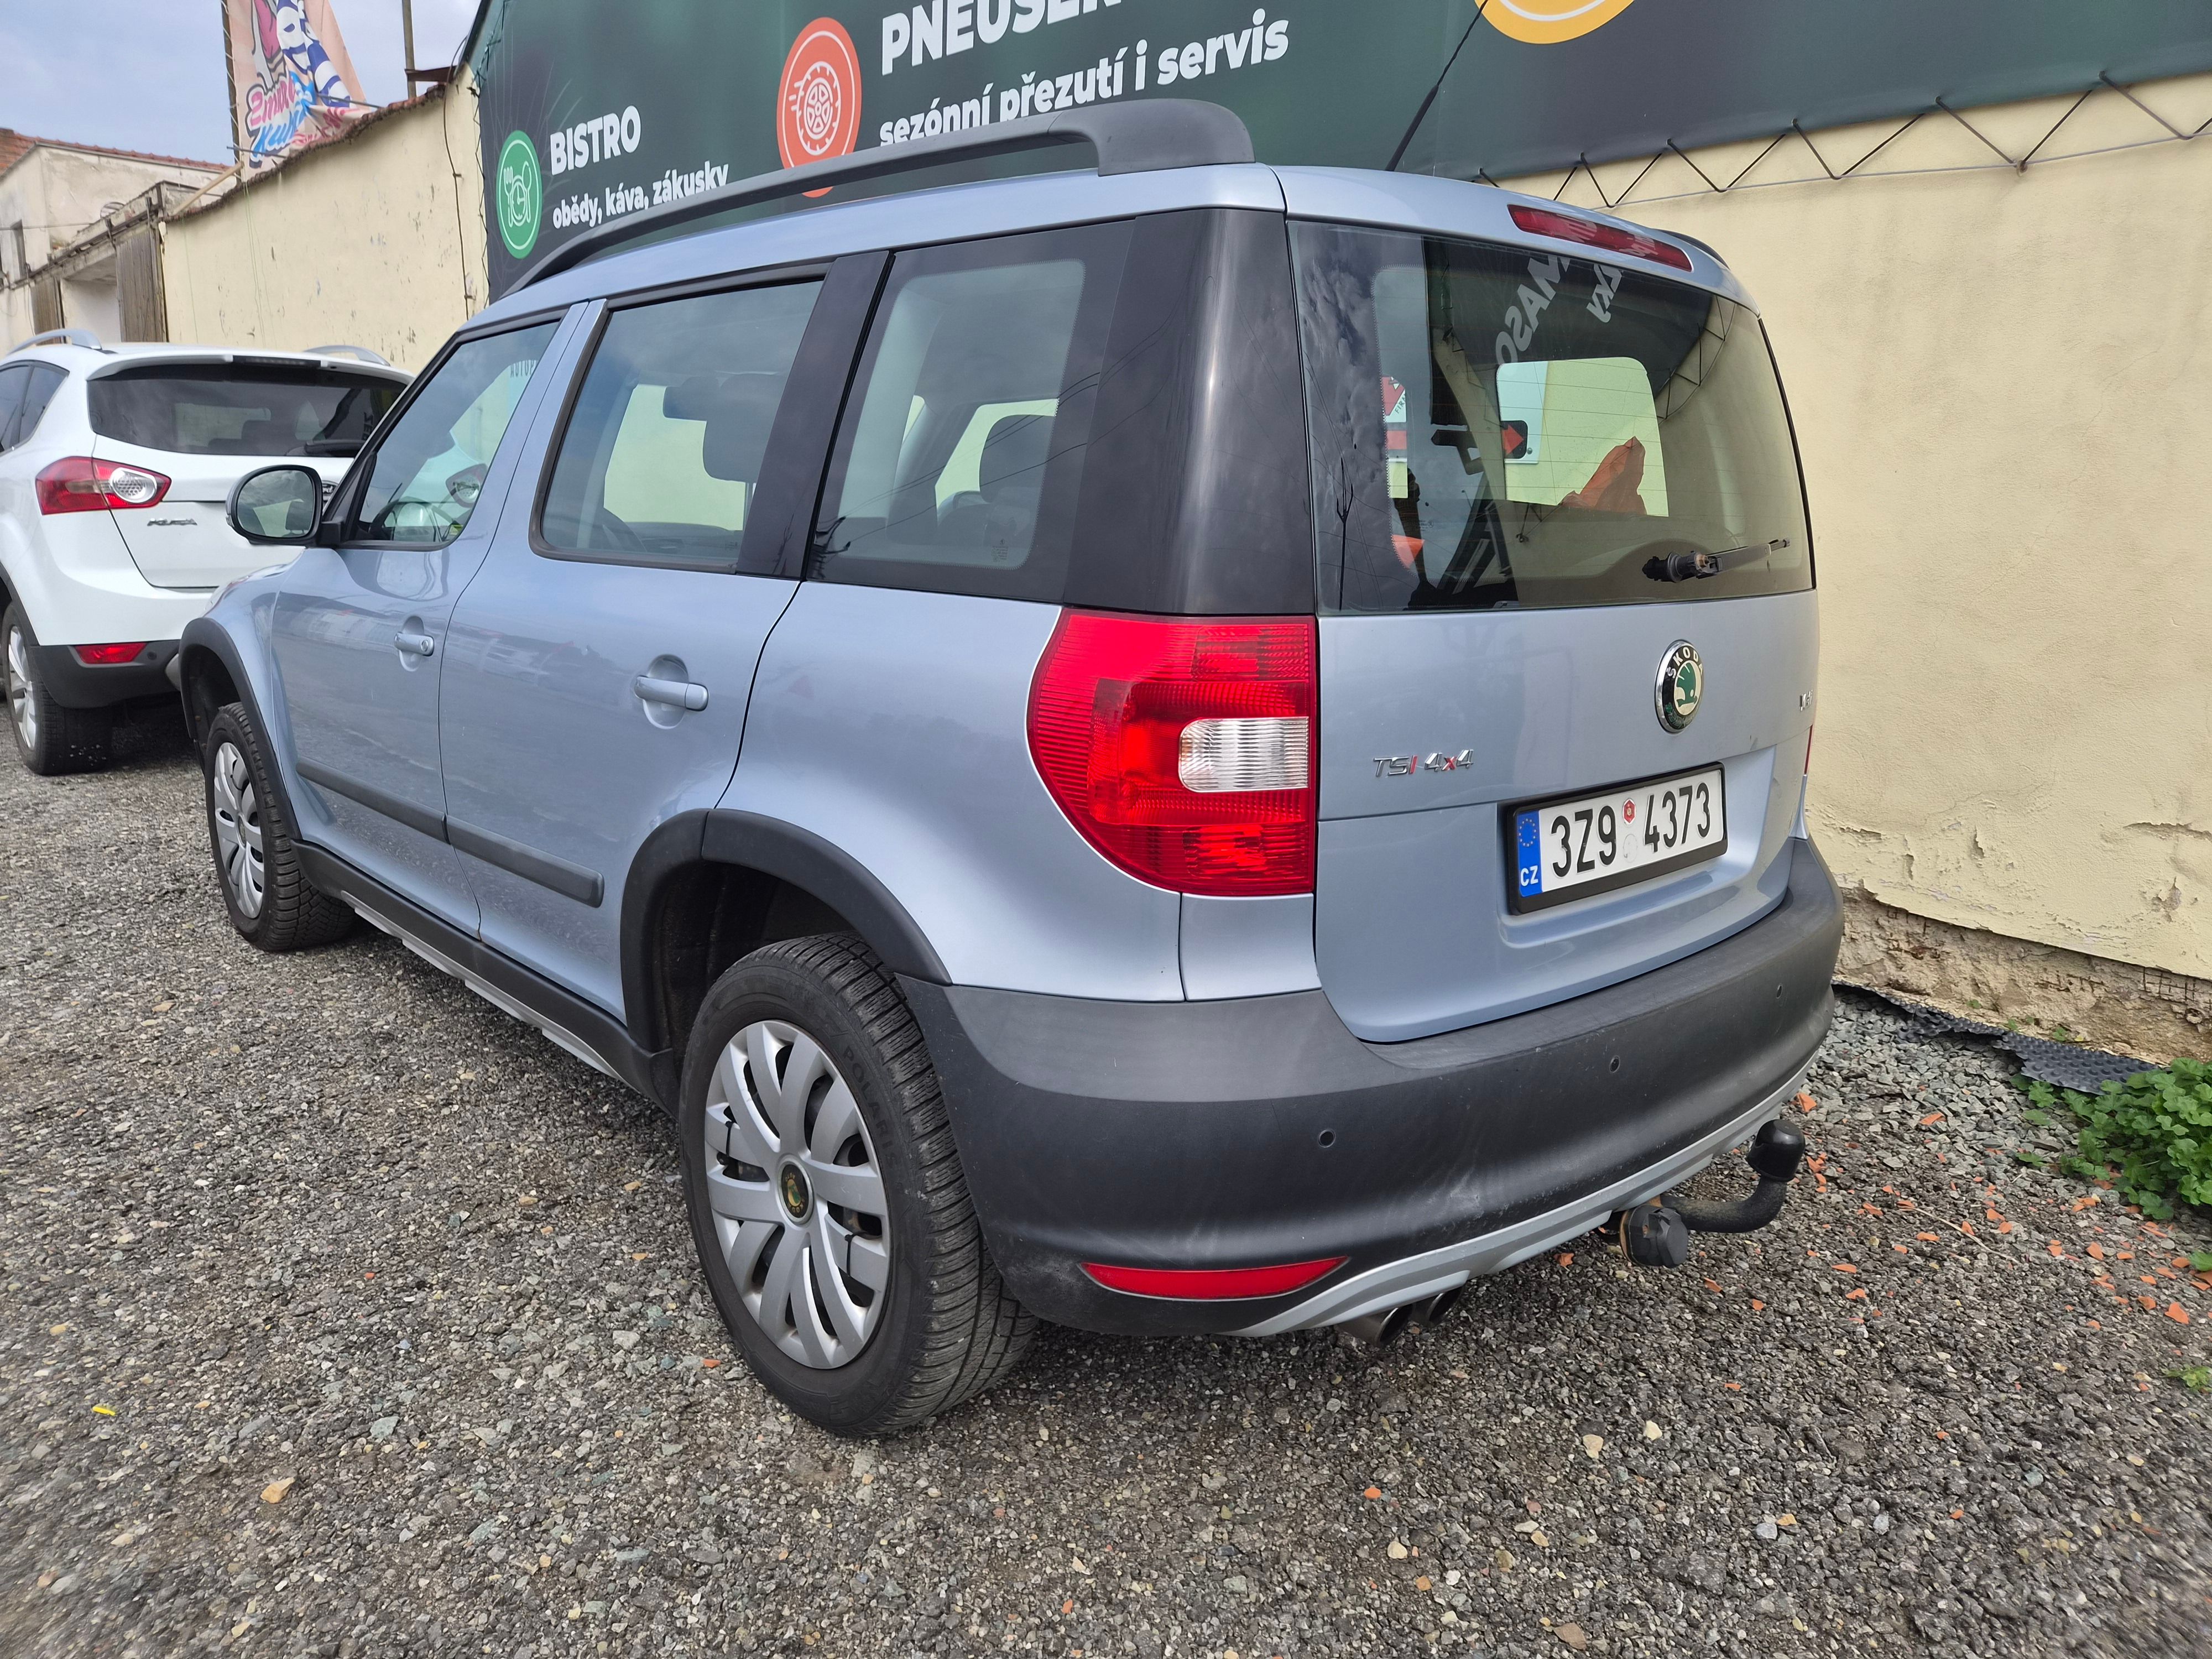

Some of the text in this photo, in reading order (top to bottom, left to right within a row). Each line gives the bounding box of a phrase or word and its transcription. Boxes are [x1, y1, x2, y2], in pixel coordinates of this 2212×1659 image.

[879, 8, 1290, 147] sezónní přezutí i servis
[550, 105, 642, 175] BISTRO
[552, 160, 729, 229] obědy, káva, zákusky
[1373, 749, 1474, 778] TSI 4x4
[1551, 782, 1711, 878] 3Z9 4373
[1520, 865, 1539, 887] CZ
